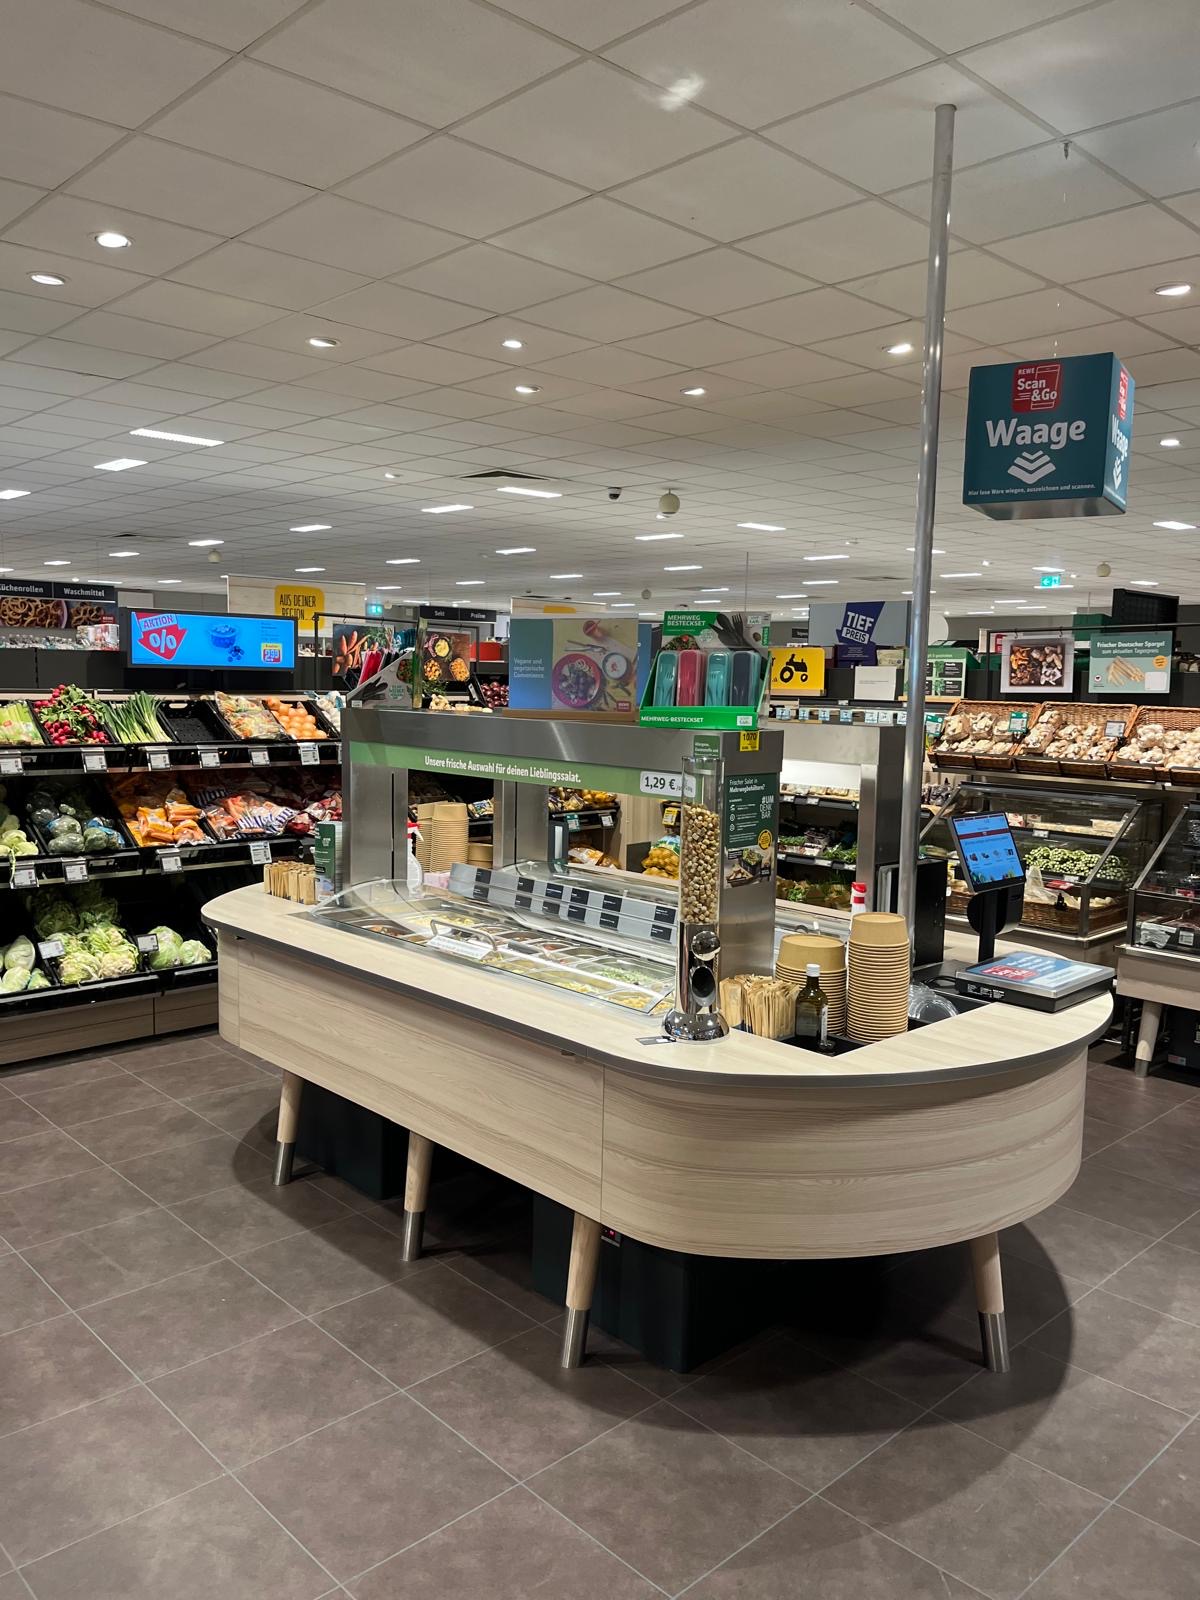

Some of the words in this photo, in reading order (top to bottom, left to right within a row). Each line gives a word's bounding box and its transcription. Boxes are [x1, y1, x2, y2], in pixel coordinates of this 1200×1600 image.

[1017, 378, 1046, 391] Scan
[1031, 387, 1058, 402] &Go
[985, 418, 1087, 450] Waage
[63, 587, 105, 597] Waschmittel
[279, 593, 292, 606] AUS
[293, 594, 317, 608] DEINER
[143, 614, 174, 630] AKTION
[846, 611, 874, 631] TIEF
[844, 629, 868, 643] PREIS
[1145, 640, 1165, 648] Spargel
[641, 715, 704, 723] MEHRWEG-BESTECKSET
[424, 755, 446, 768] Unsere
[446, 758, 467, 770] frische
[467, 760, 495, 773] Auswahl
[495, 763, 505, 774] für
[506, 765, 529, 777] deinen
[529, 766, 582, 783] Lieblingssalat.
[644, 776, 666, 790] 1,29
[669, 778, 676, 790] €
